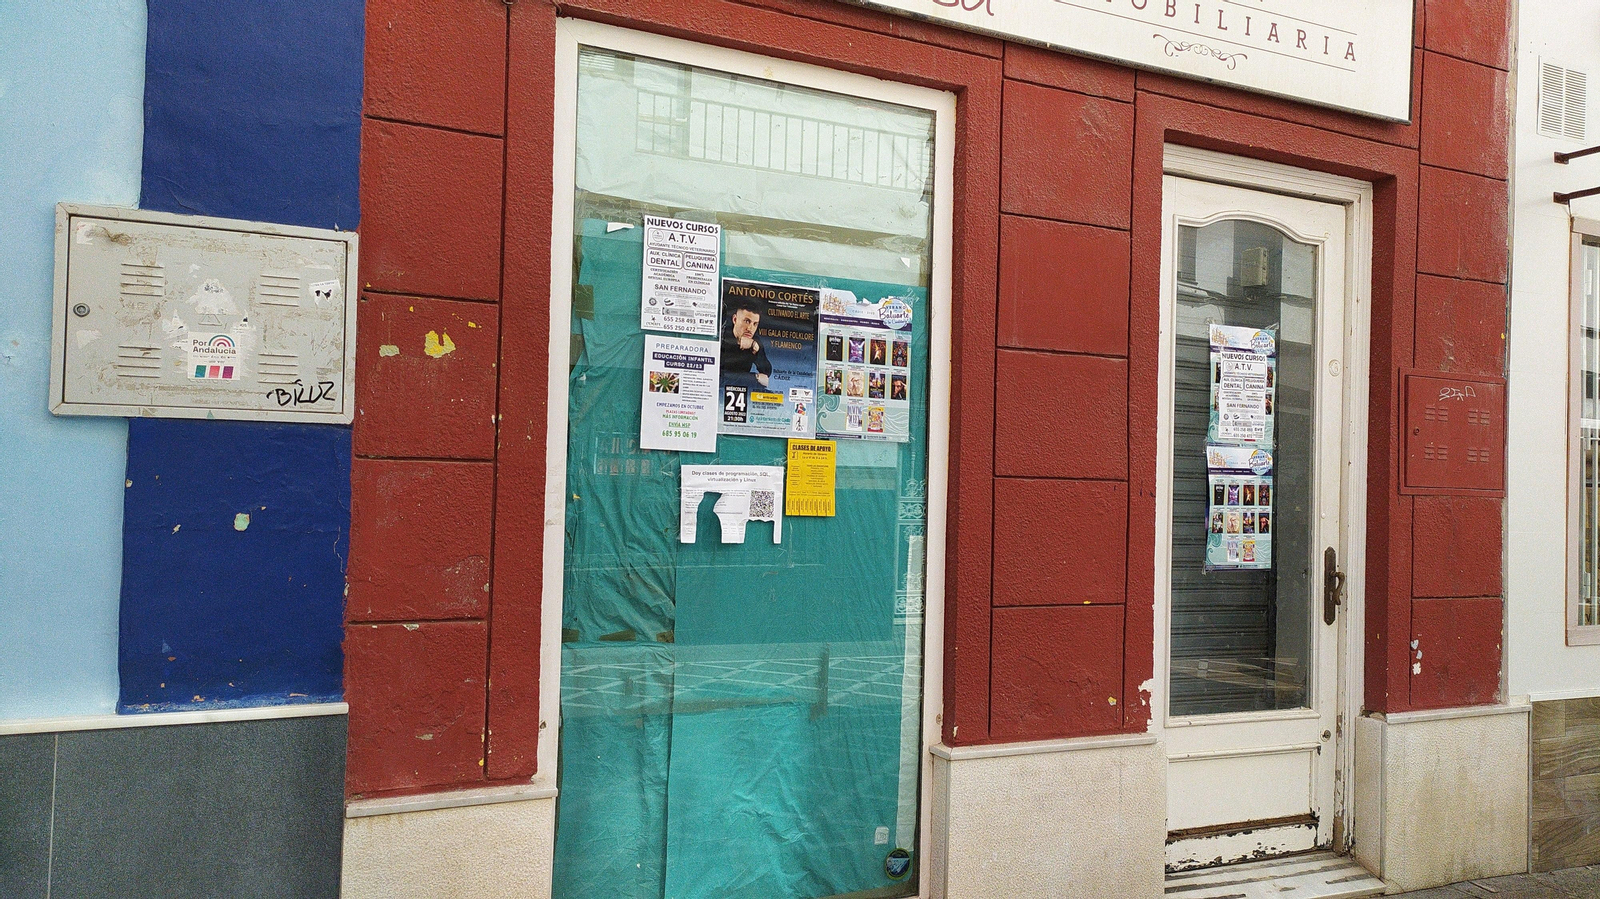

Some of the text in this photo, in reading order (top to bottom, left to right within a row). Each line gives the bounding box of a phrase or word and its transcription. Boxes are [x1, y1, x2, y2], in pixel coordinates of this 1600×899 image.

[647, 218, 718, 234] NUEVOS CURSOS
[669, 233, 696, 244] A.T.V.
[651, 257, 680, 266] DENTAL
[686, 261, 714, 270] CANINA
[670, 286, 706, 295] FERNANDO
[729, 286, 814, 304] ANTONIO CORTÉS
[768, 308, 794, 318] CULTIVANDO
[878, 307, 909, 320] Baluarte
[768, 329, 781, 338] GALA
[790, 332, 814, 340] FOLKLORE
[193, 346, 236, 354] Andalucía
[656, 343, 709, 353] PREPARADORA
[776, 341, 802, 350] FLAMENCO
[654, 353, 713, 364] EDUCACIÓN INFANTIL
[1235, 363, 1253, 371] A.T.V.
[726, 392, 746, 411] 24
